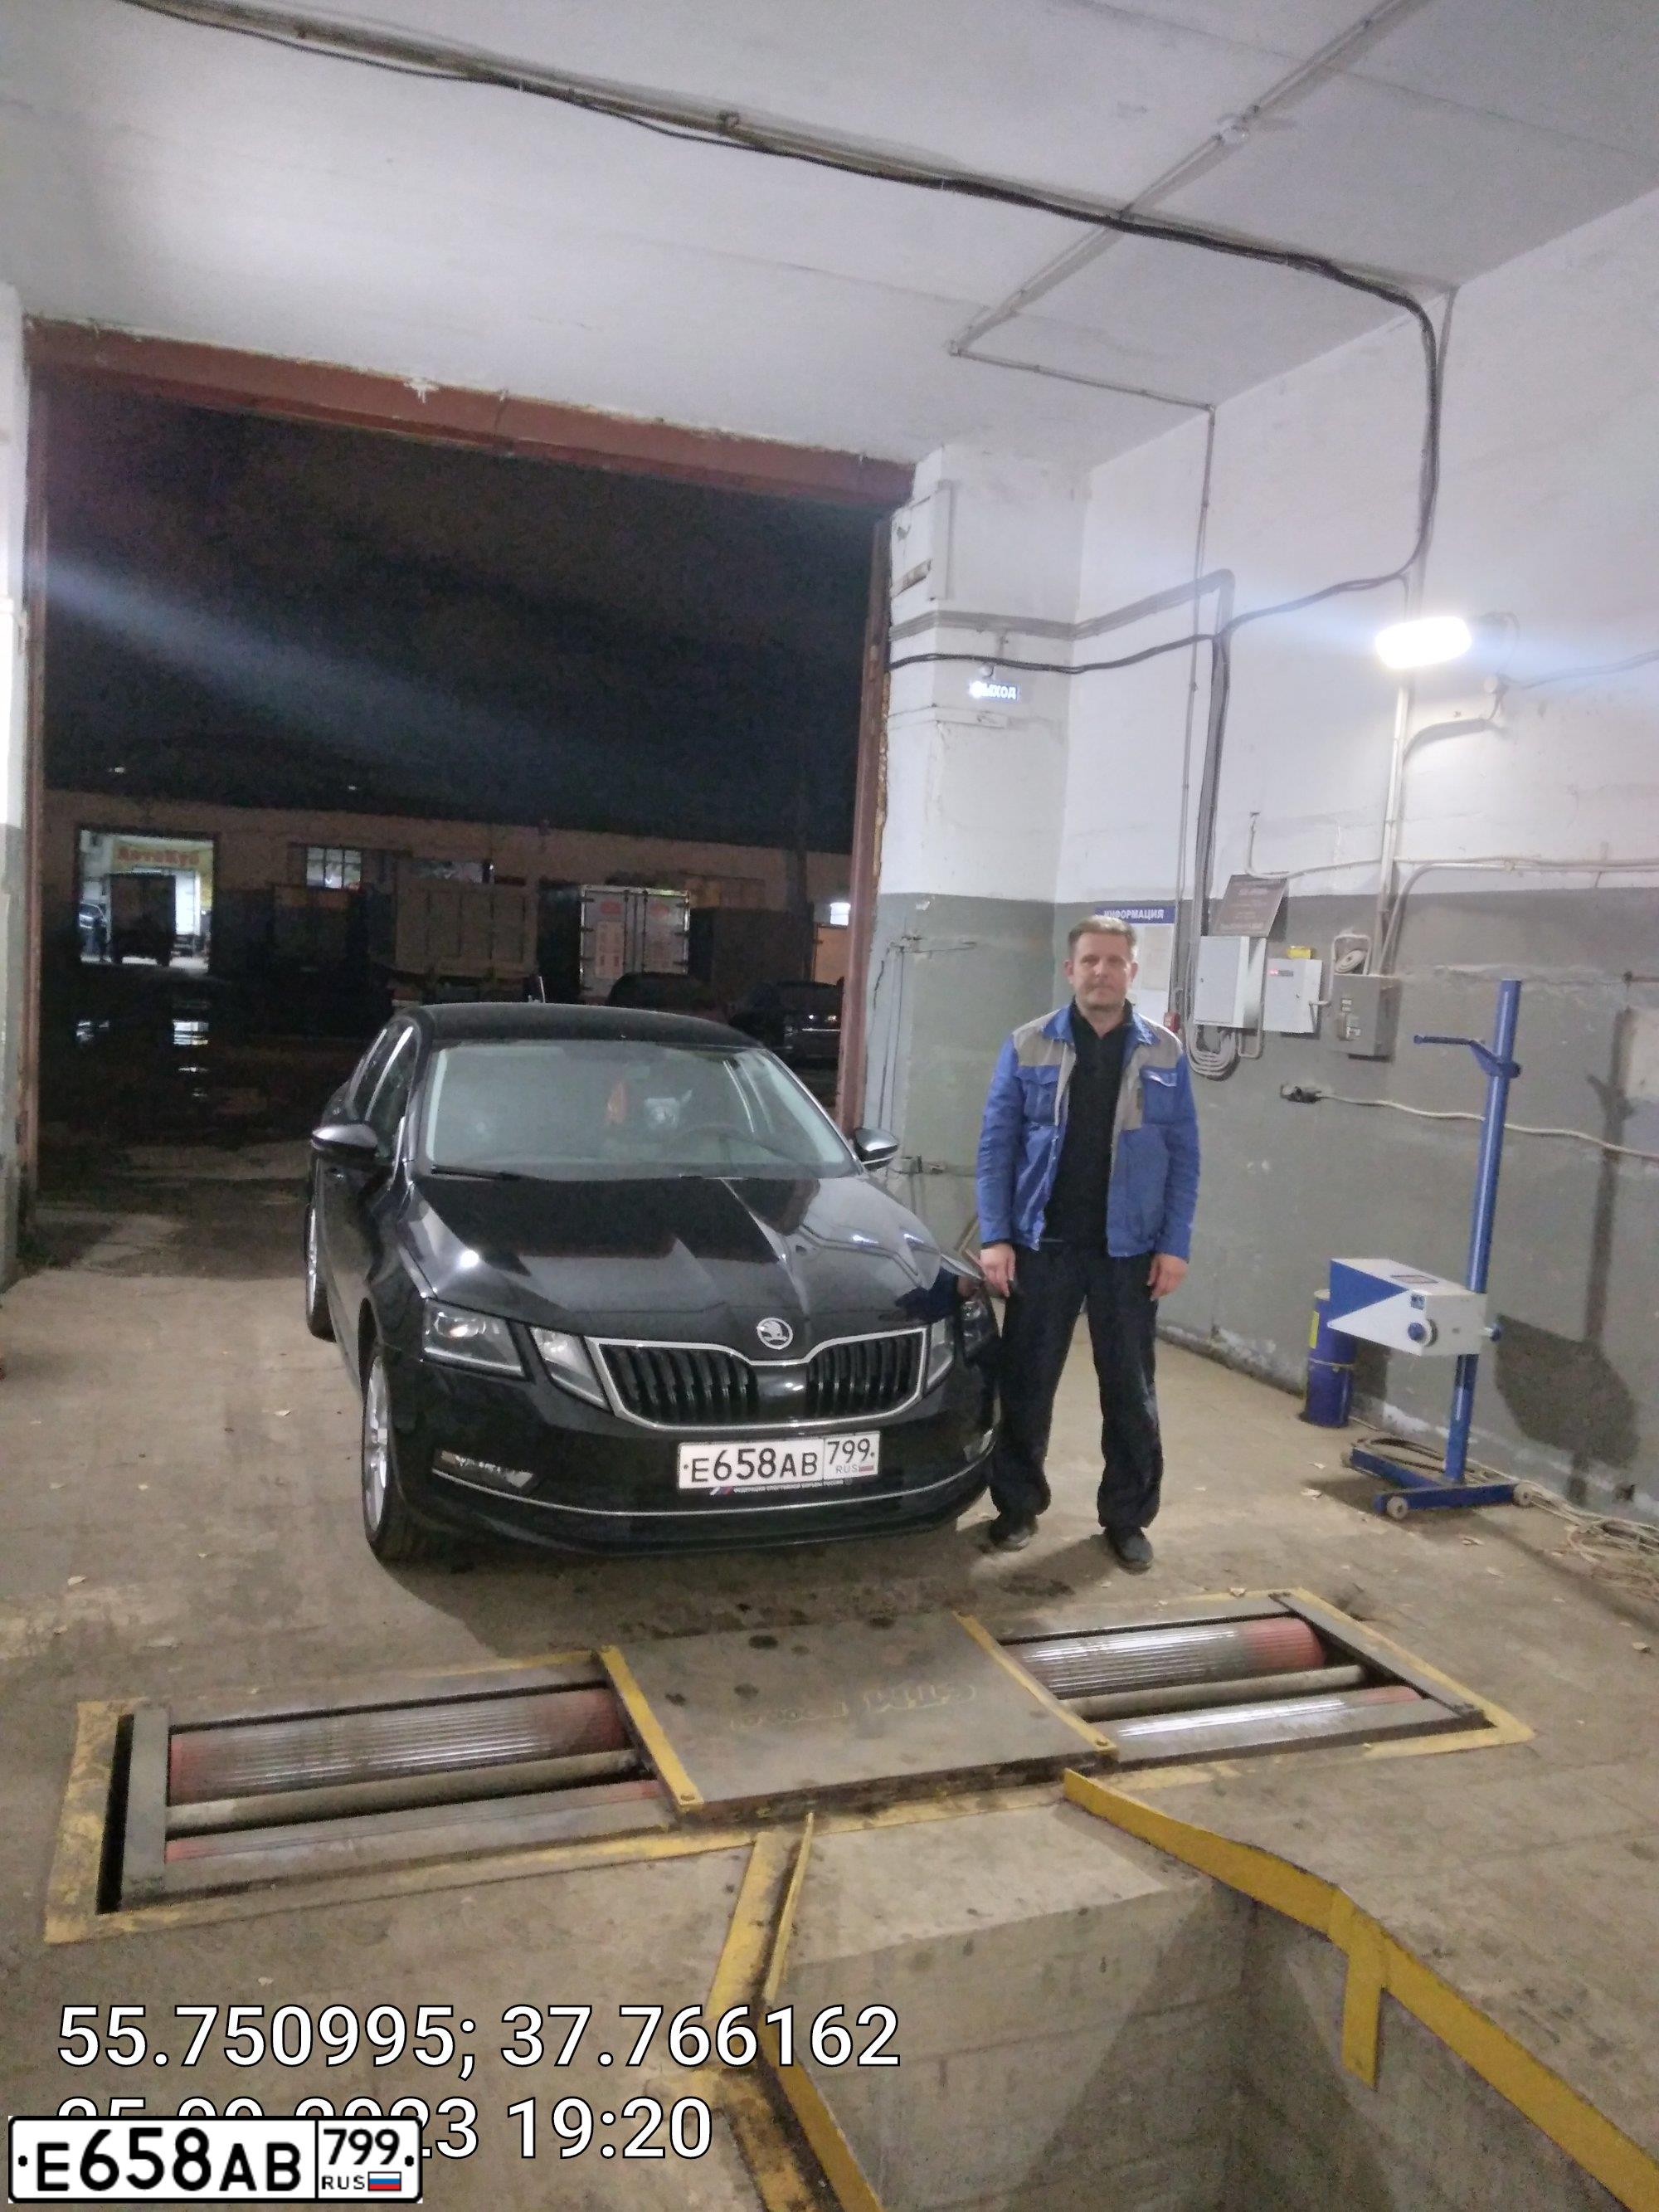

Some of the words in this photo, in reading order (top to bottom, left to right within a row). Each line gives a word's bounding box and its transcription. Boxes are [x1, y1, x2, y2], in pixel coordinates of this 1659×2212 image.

[1104, 909, 1164, 920] ИНФОРМАЦИЯ
[690, 1447, 818, 1484] Е658АВ
[827, 1438, 871, 1464] 799
[835, 1465, 858, 1474] RUS
